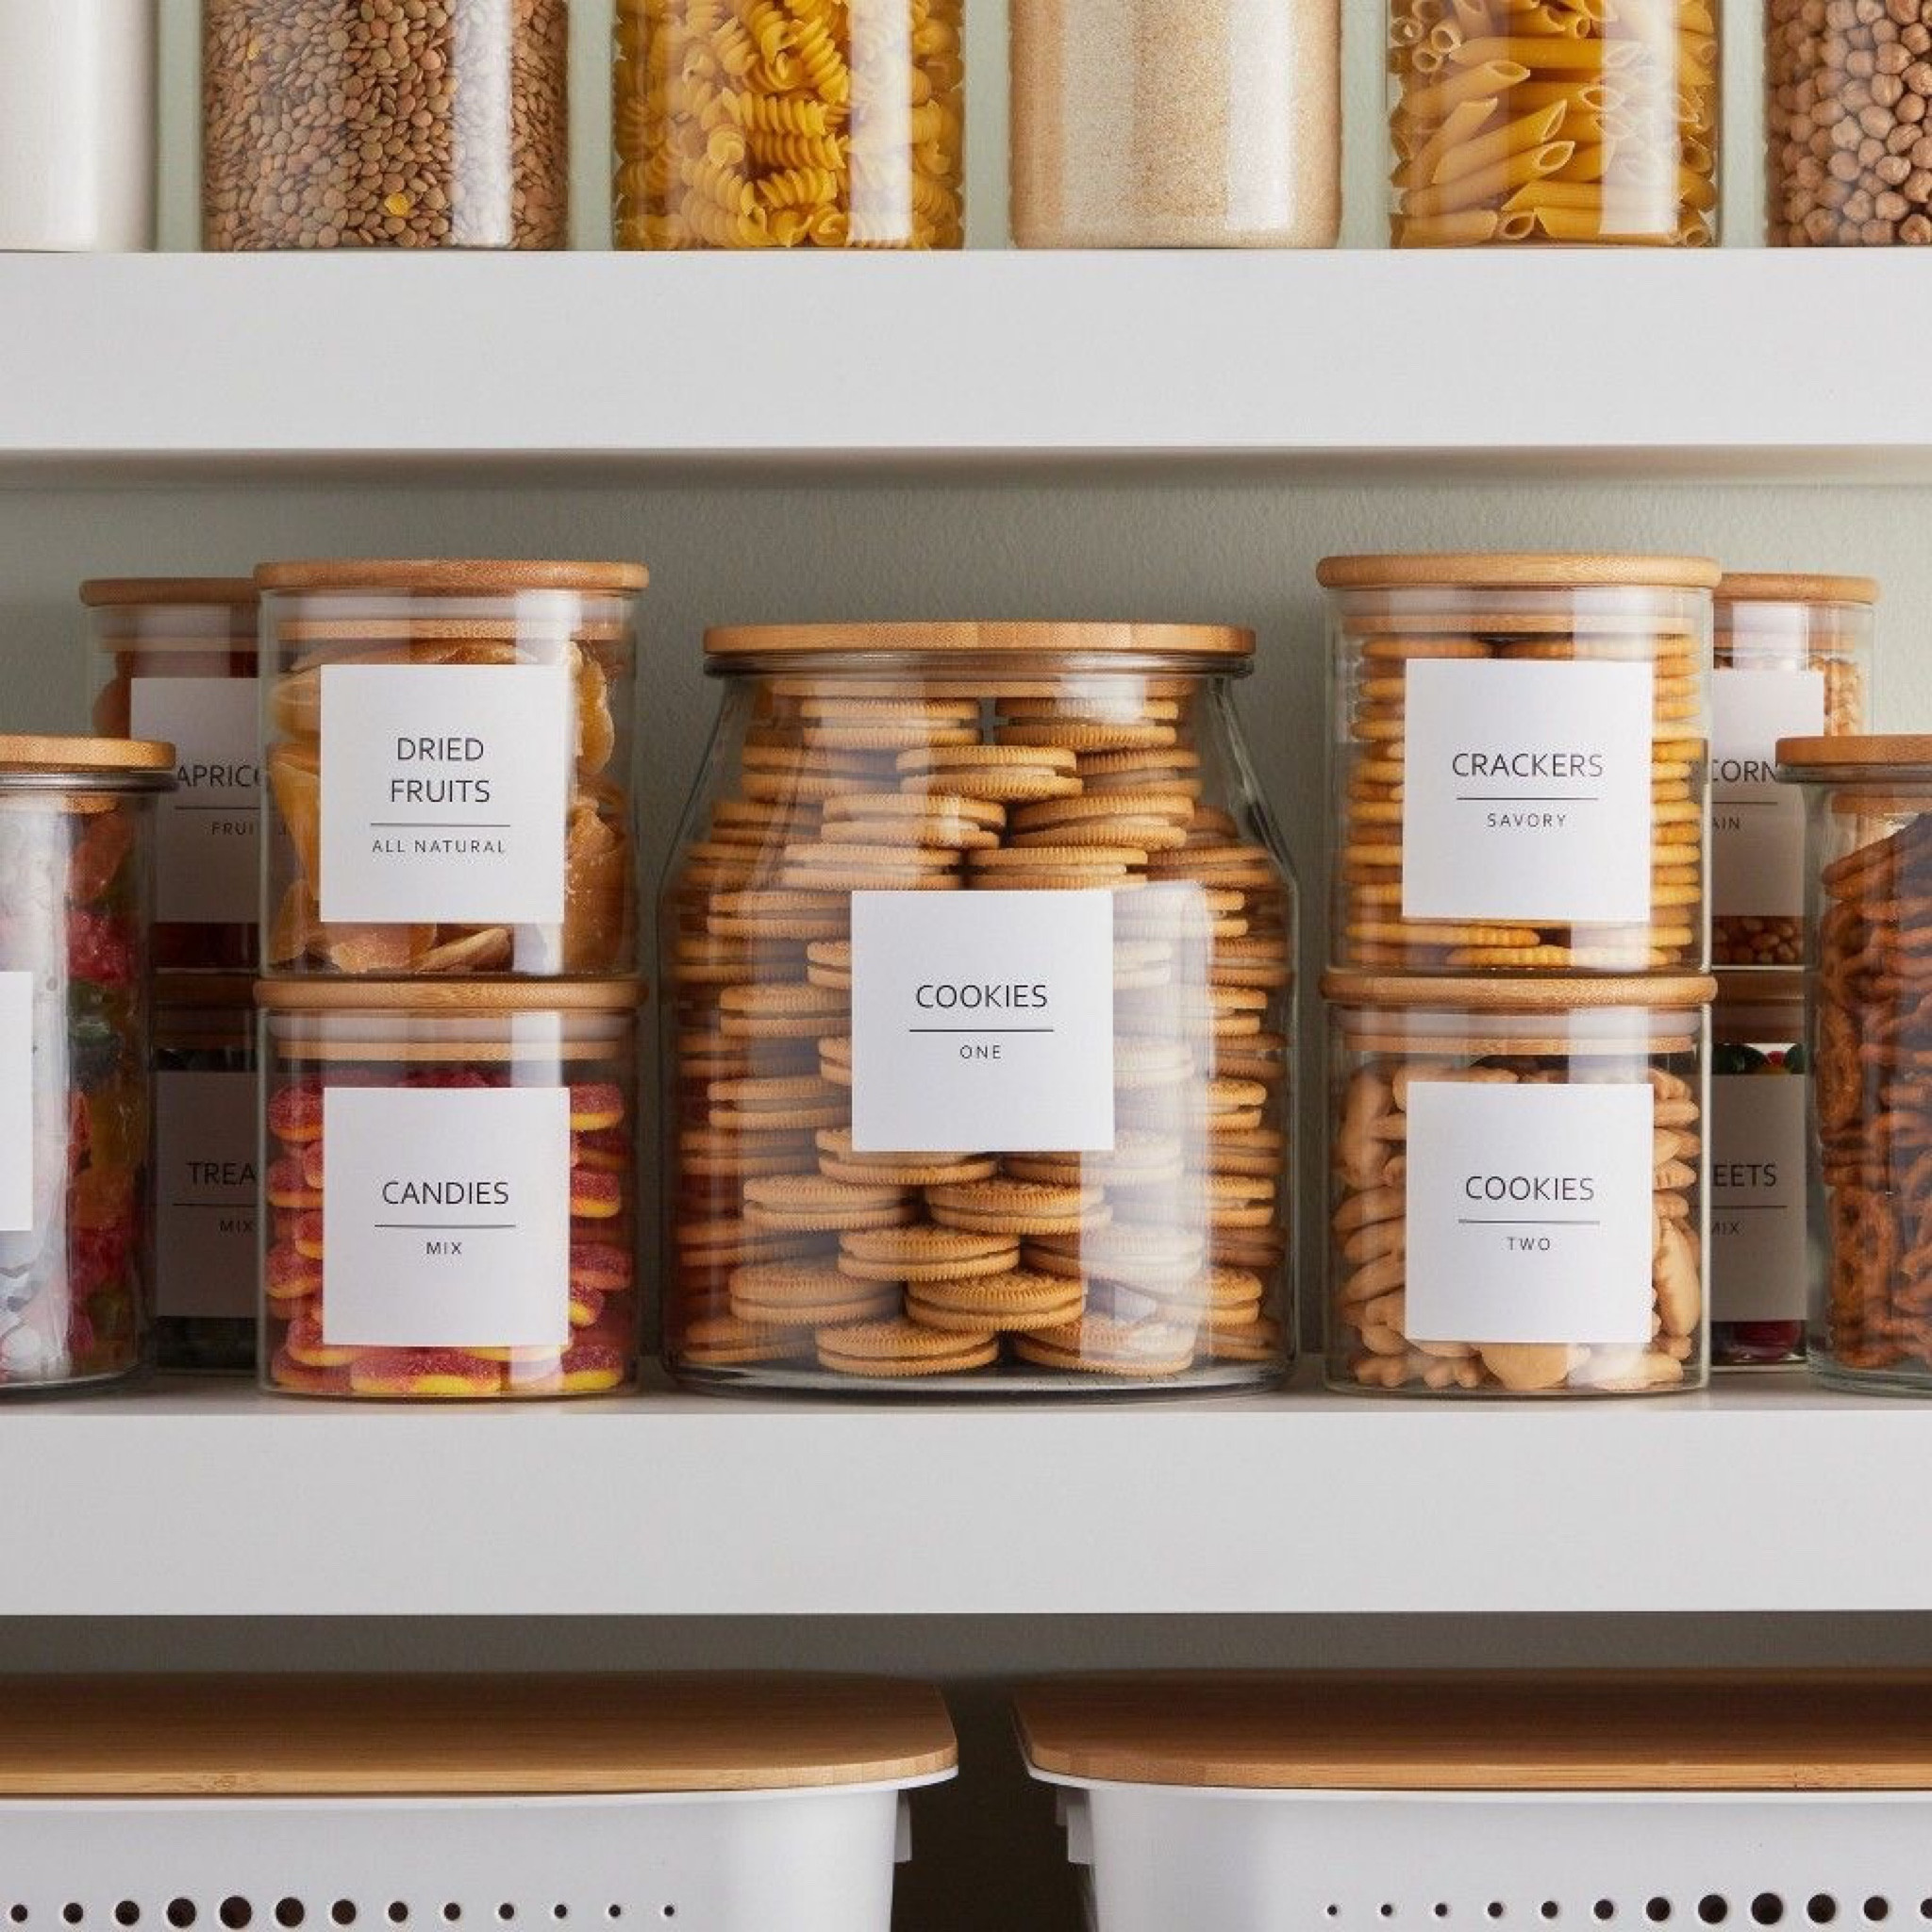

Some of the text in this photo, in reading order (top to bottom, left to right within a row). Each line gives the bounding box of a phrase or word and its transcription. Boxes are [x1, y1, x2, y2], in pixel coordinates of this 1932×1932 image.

[397, 737, 484, 762] DRIED
[1452, 753, 1603, 777] CRACKERS
[391, 778, 491, 803] FRUITS
[1487, 812, 1566, 828] SAVORY
[372, 840, 507, 854] ALL NATURAL
[915, 984, 1048, 1009] COOKIES
[959, 1044, 1002, 1059] ONE
[382, 1181, 509, 1205] CANDIES
[1465, 1175, 1595, 1201] COOKIES
[219, 1220, 254, 1233] MIX
[425, 1241, 462, 1255] MIX
[1507, 1236, 1551, 1251] TWO
